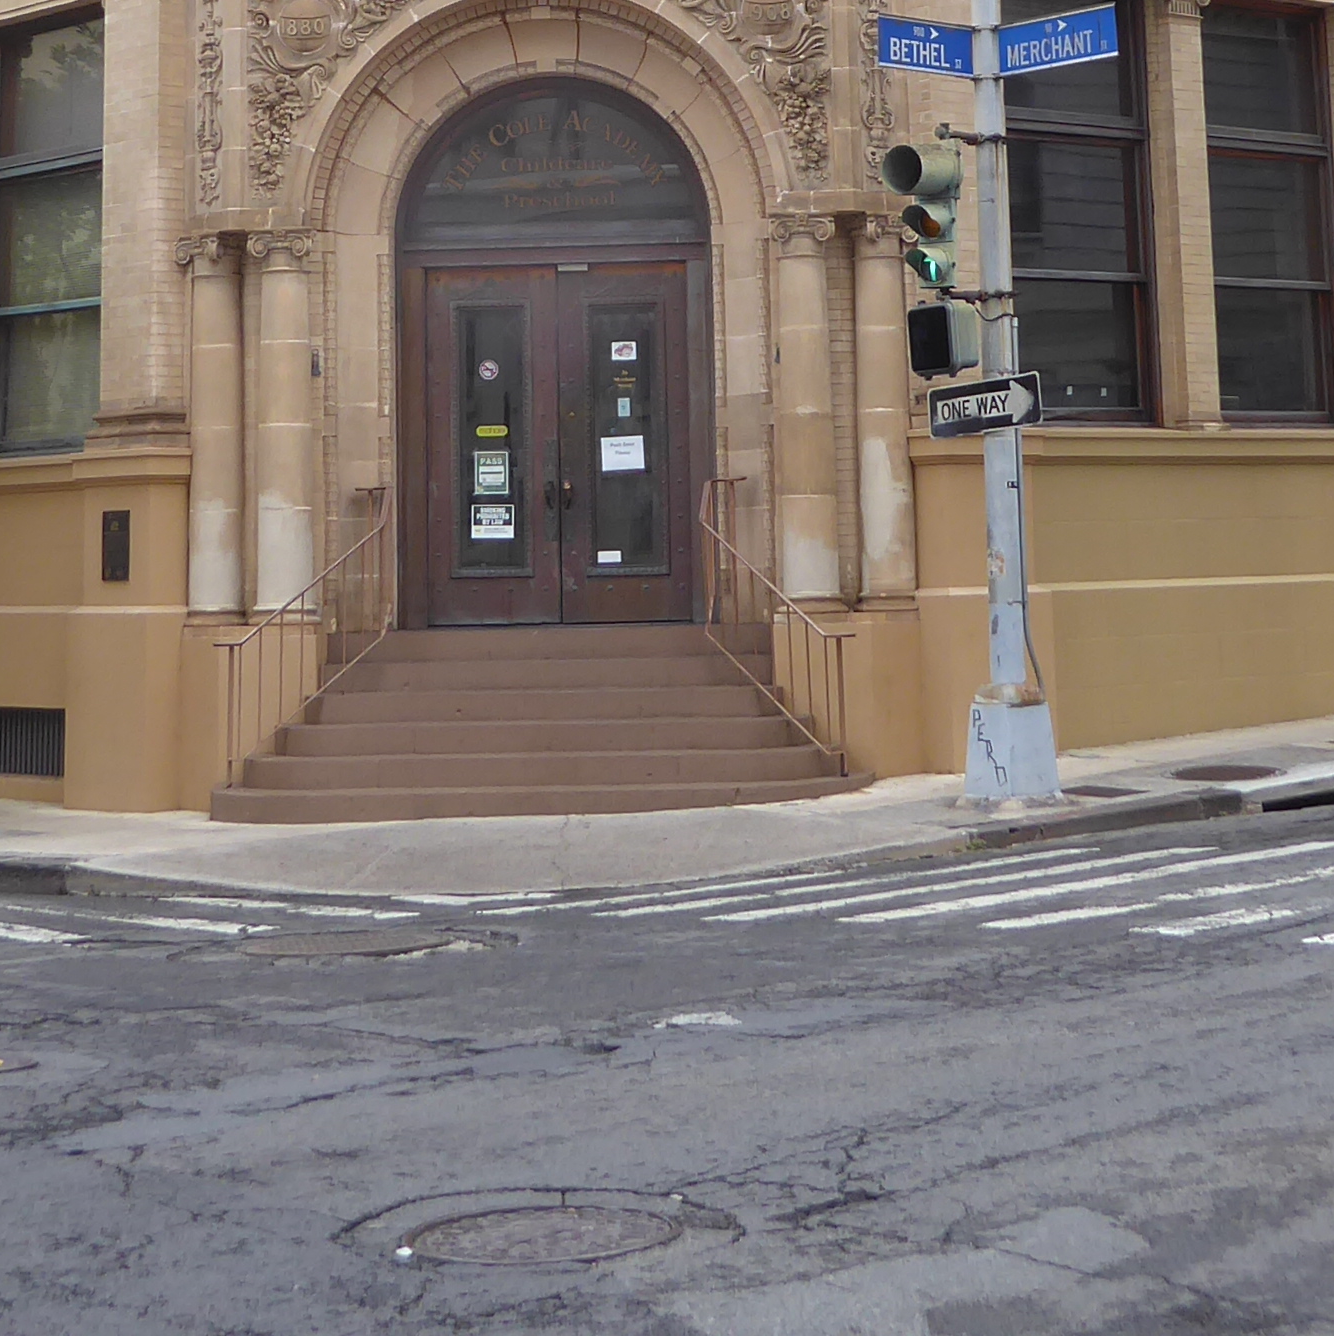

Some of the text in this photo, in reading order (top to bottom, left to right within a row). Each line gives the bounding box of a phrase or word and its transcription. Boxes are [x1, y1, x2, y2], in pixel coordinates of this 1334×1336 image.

[281, 18, 324, 36] 1880
[889, 36, 951, 68] BETHEL
[1006, 29, 1094, 69] MERCHANT
[941, 393, 1009, 421] ONE WAY
